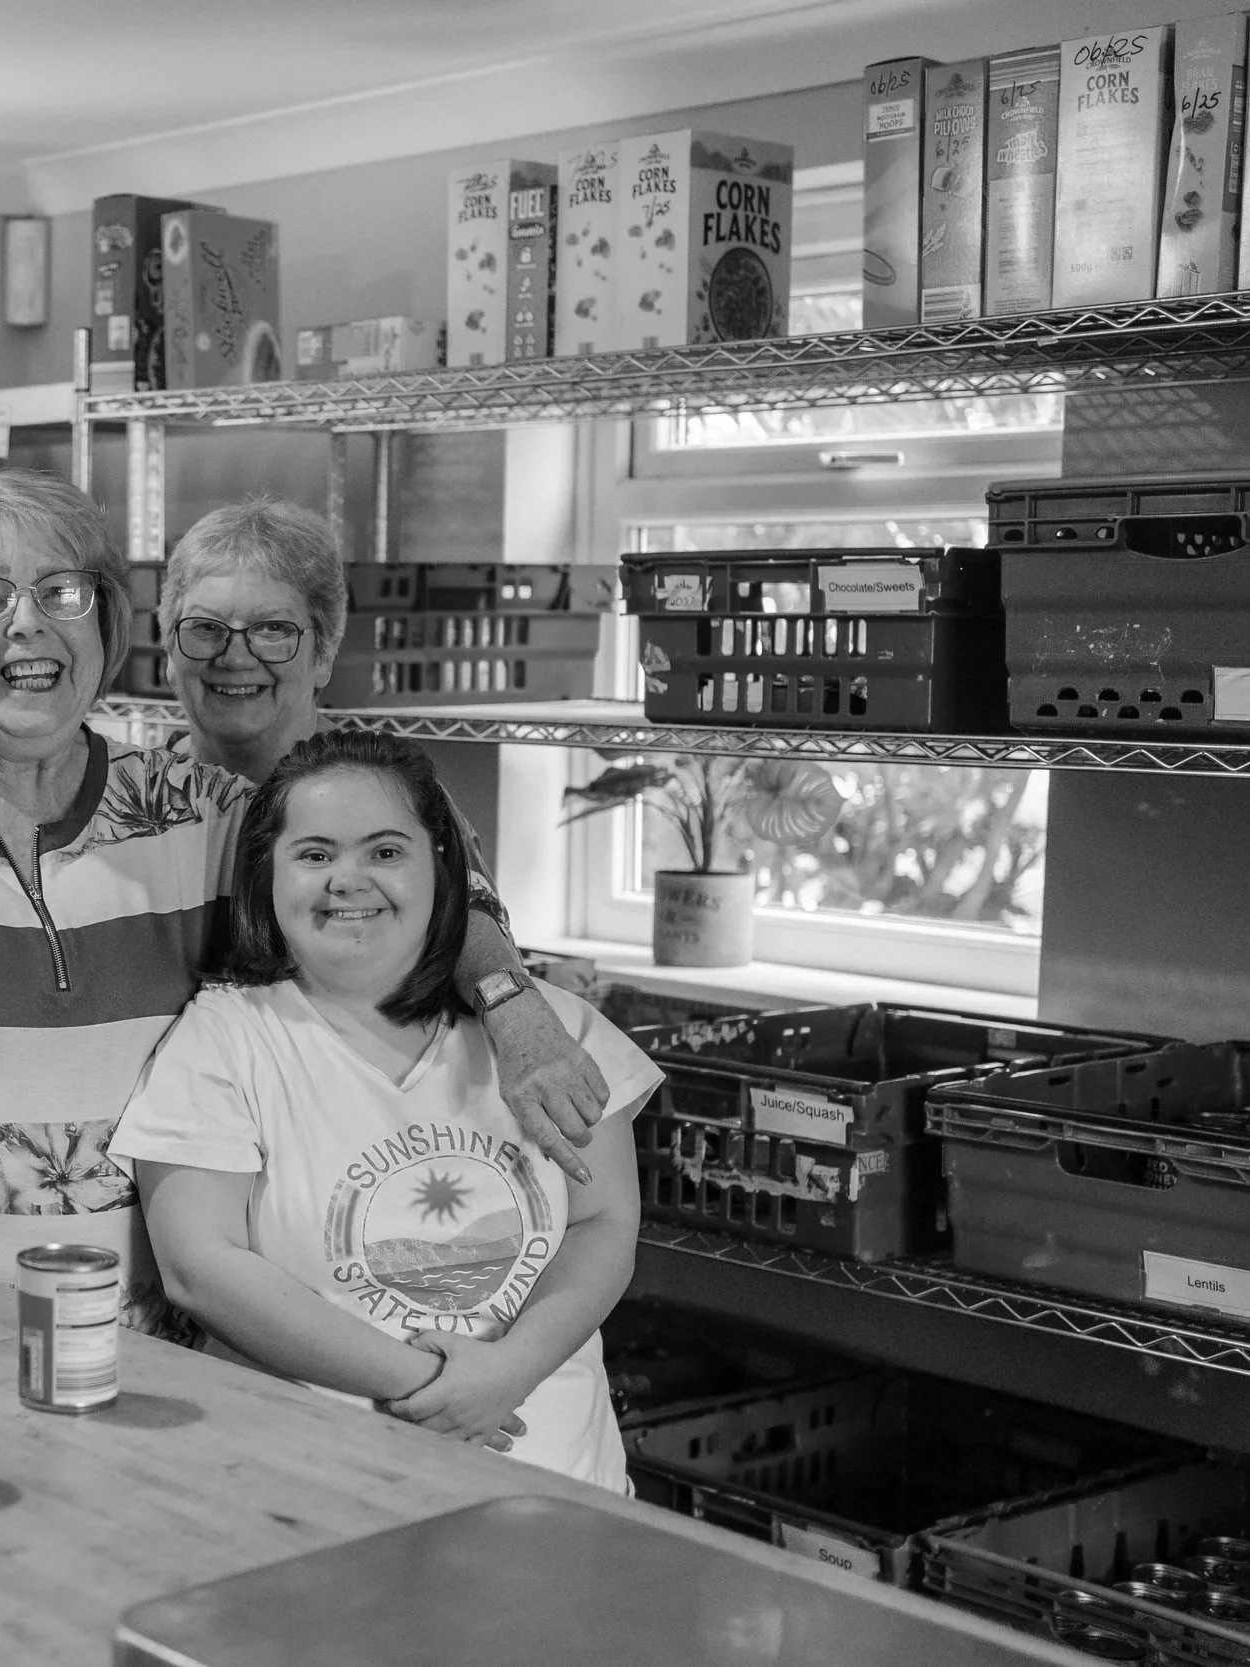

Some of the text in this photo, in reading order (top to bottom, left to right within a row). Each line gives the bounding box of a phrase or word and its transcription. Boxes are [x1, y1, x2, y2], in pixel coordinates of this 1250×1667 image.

[1074, 35, 1149, 67] 06/25
[870, 71, 911, 98] 06/25
[1086, 71, 1130, 92] CORN
[1001, 81, 1041, 107] 6/25
[1077, 87, 1140, 112] FLAKES
[1181, 87, 1222, 119] 6/25
[879, 119, 904, 130] HOOPS
[935, 108, 952, 121] MILK
[934, 117, 977, 137] PILLOWS
[575, 176, 606, 192] CORN
[639, 166, 670, 182] CORN
[569, 190, 612, 208] FLAKES
[632, 180, 677, 200] FLAKES
[716, 180, 770, 217] CORN
[463, 195, 492, 209] CORN
[458, 206, 497, 224] FLAKES
[703, 211, 781, 254] FLAKES
[828, 581, 915, 594] Chocolate/Sweets
[760, 1094, 845, 1123] Juice/Squash
[347, 1123, 521, 1189] SUNSHINE
[488, 1236, 550, 1323] MIND
[1187, 1275, 1226, 1293] Lentils
[333, 1262, 427, 1333] STATE
[434, 1311, 480, 1334] OF
